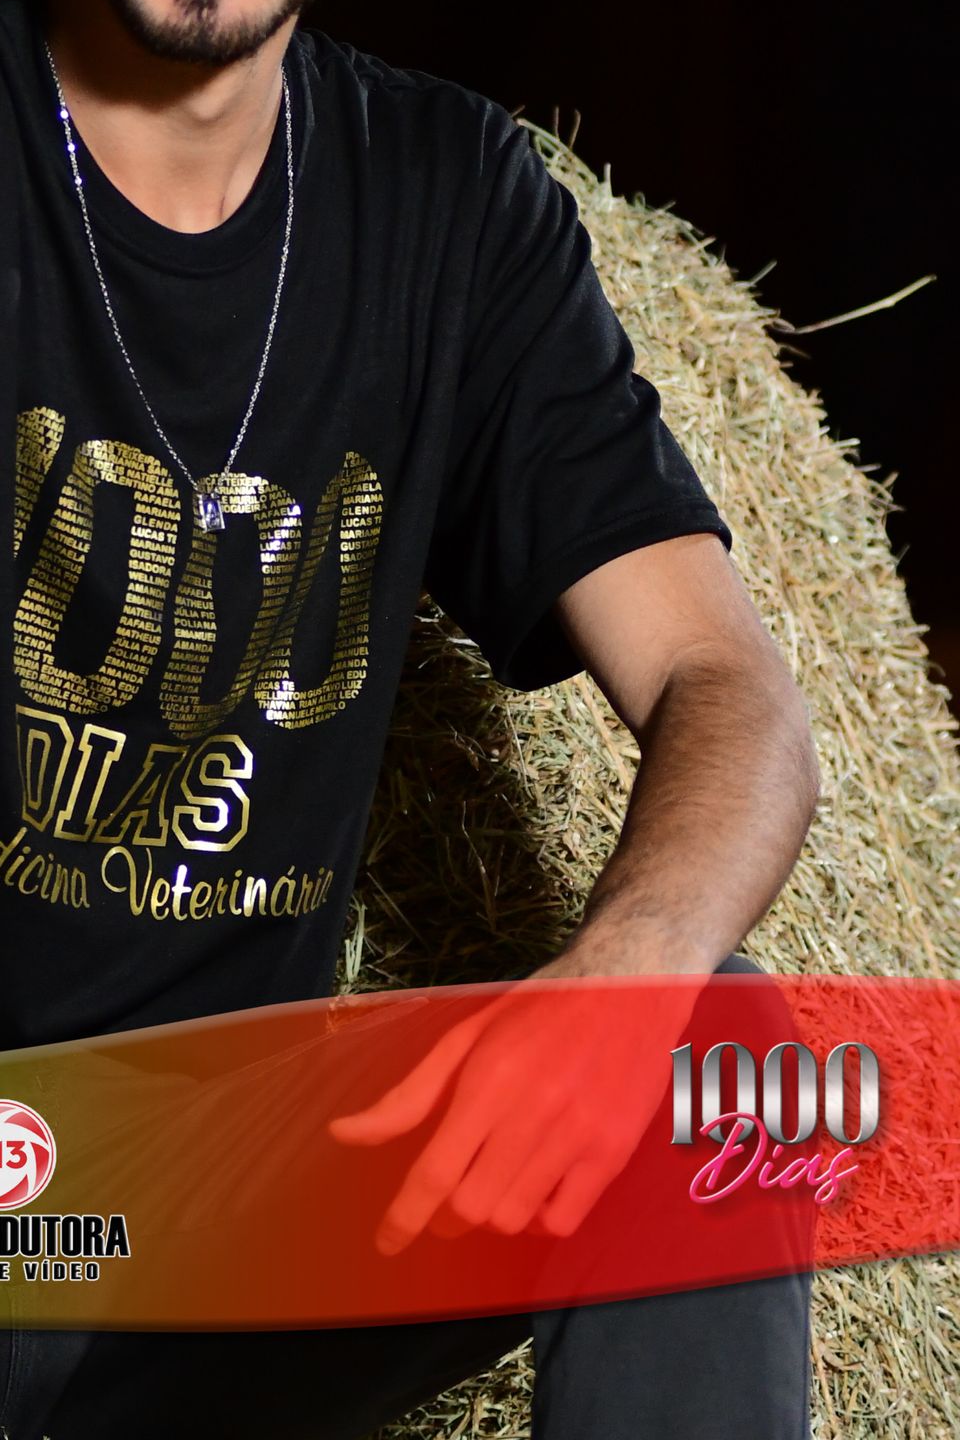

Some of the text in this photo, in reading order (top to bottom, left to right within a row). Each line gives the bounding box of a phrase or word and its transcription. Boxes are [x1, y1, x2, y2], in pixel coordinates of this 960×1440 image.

[127, 469, 174, 488] NATIELLE
[147, 465, 171, 478] SAN
[100, 470, 156, 493] TOLENTINO
[257, 484, 282, 494] SAN
[342, 482, 382, 495] RAFAELA
[134, 491, 181, 510] RAFAELA
[269, 489, 290, 500] NAT
[343, 494, 383, 505] MARIANA
[135, 503, 181, 521] MARIANA
[253, 505, 301, 521] RAFAELA
[342, 505, 382, 516] GLENDA
[133, 514, 178, 533] GLENDA
[258, 518, 302, 530] MARIANA
[341, 517, 373, 528] LUCAS
[131, 525, 165, 542] LUCAS
[259, 529, 302, 540] GLENDA
[260, 540, 292, 551] LUCAS
[129, 548, 175, 566] GUSTAVO
[128, 559, 172, 577] ISADORA
[23, 589, 67, 612] AMANDA
[19, 599, 64, 622] MARIANA
[15, 609, 59, 632] RAFAELA
[119, 616, 162, 634] RAFAELA
[174, 617, 217, 630] POLIANA
[116, 626, 162, 645] MATHEUS
[14, 645, 41, 661] UCAS
[173, 640, 213, 653] AMANDA
[108, 646, 153, 666] POLIANA
[40, 664, 87, 686] EDUARDA
[99, 665, 144, 685] AMANDA
[167, 662, 206, 673] RAFAELA
[20, 679, 70, 700] EMANUELE
[63, 681, 90, 697] ALEX
[266, 707, 316, 721] EMANUELE
[15, 704, 254, 853] DIAS
